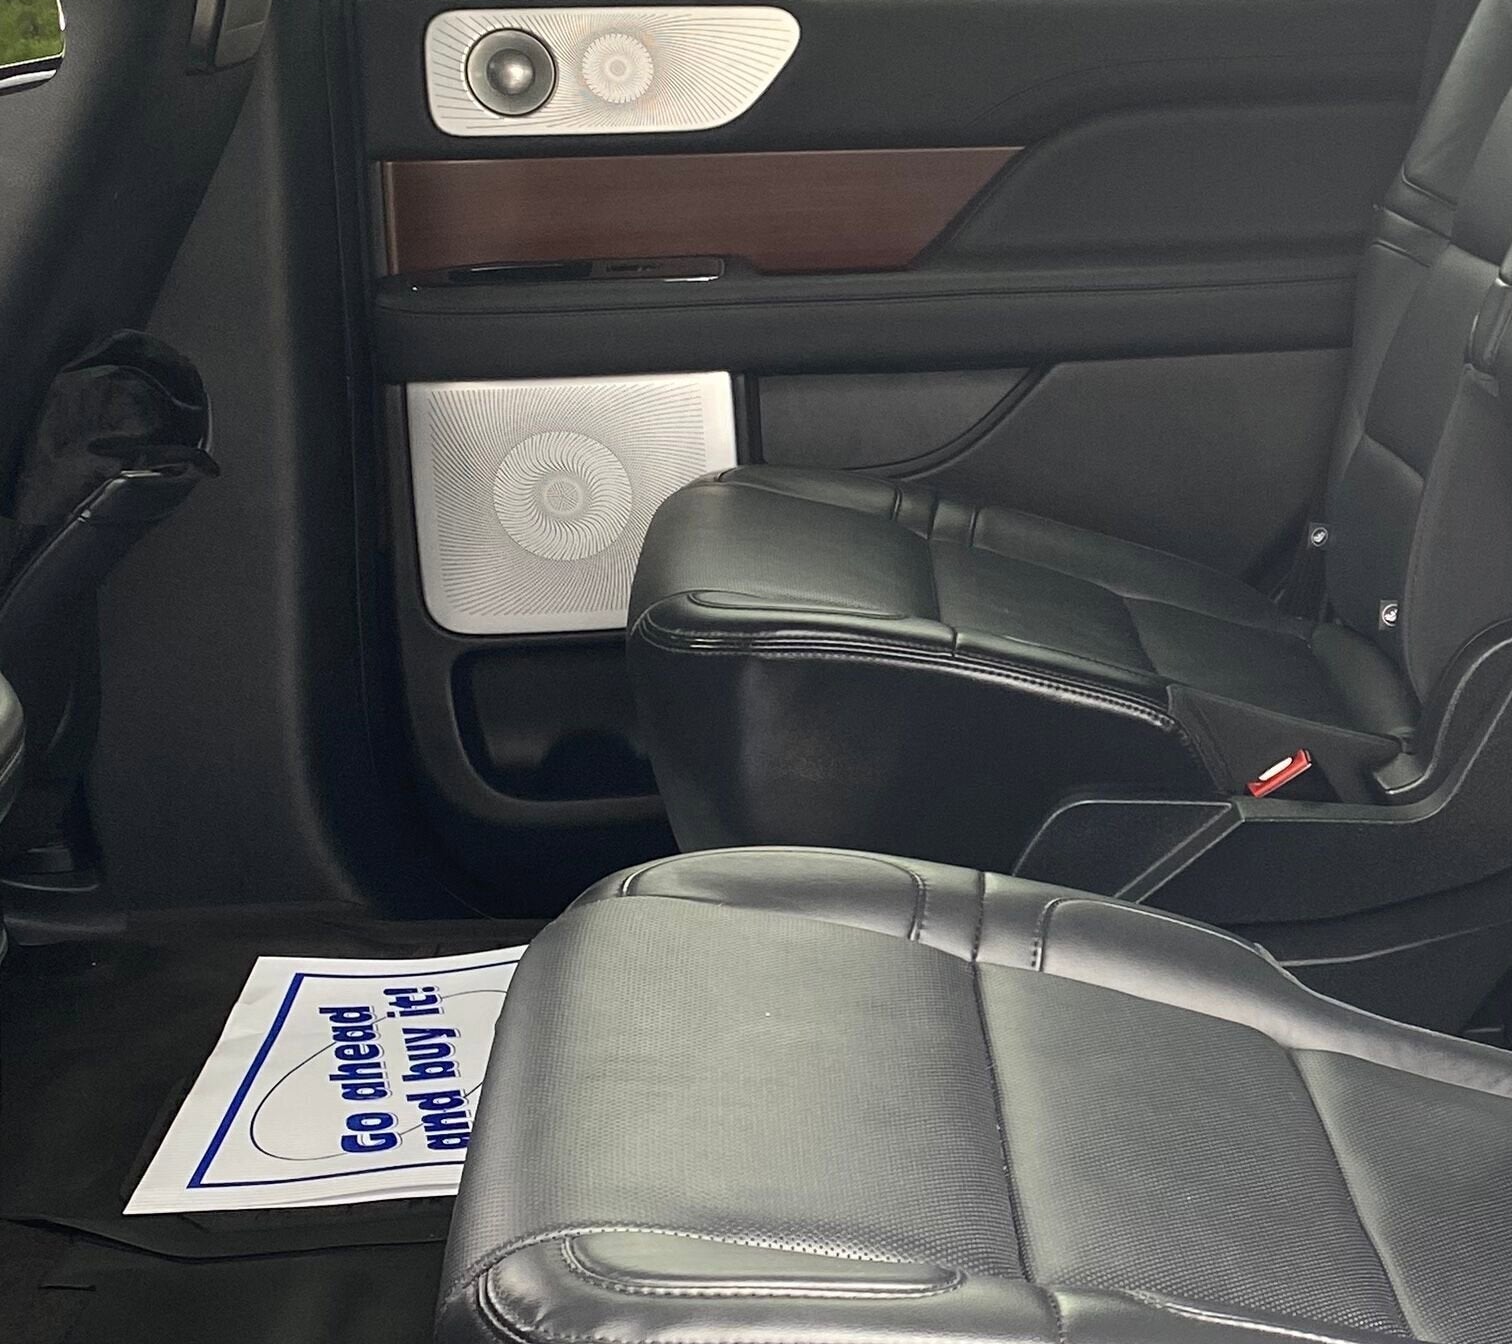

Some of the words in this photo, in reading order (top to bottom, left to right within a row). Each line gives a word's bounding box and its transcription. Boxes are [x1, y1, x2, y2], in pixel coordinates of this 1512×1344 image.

[383, 985, 444, 1018] it!
[318, 1006, 391, 1101] ahead
[402, 1027, 460, 1082] buy
[341, 1111, 400, 1154] Go
[406, 1089, 471, 1150] and
